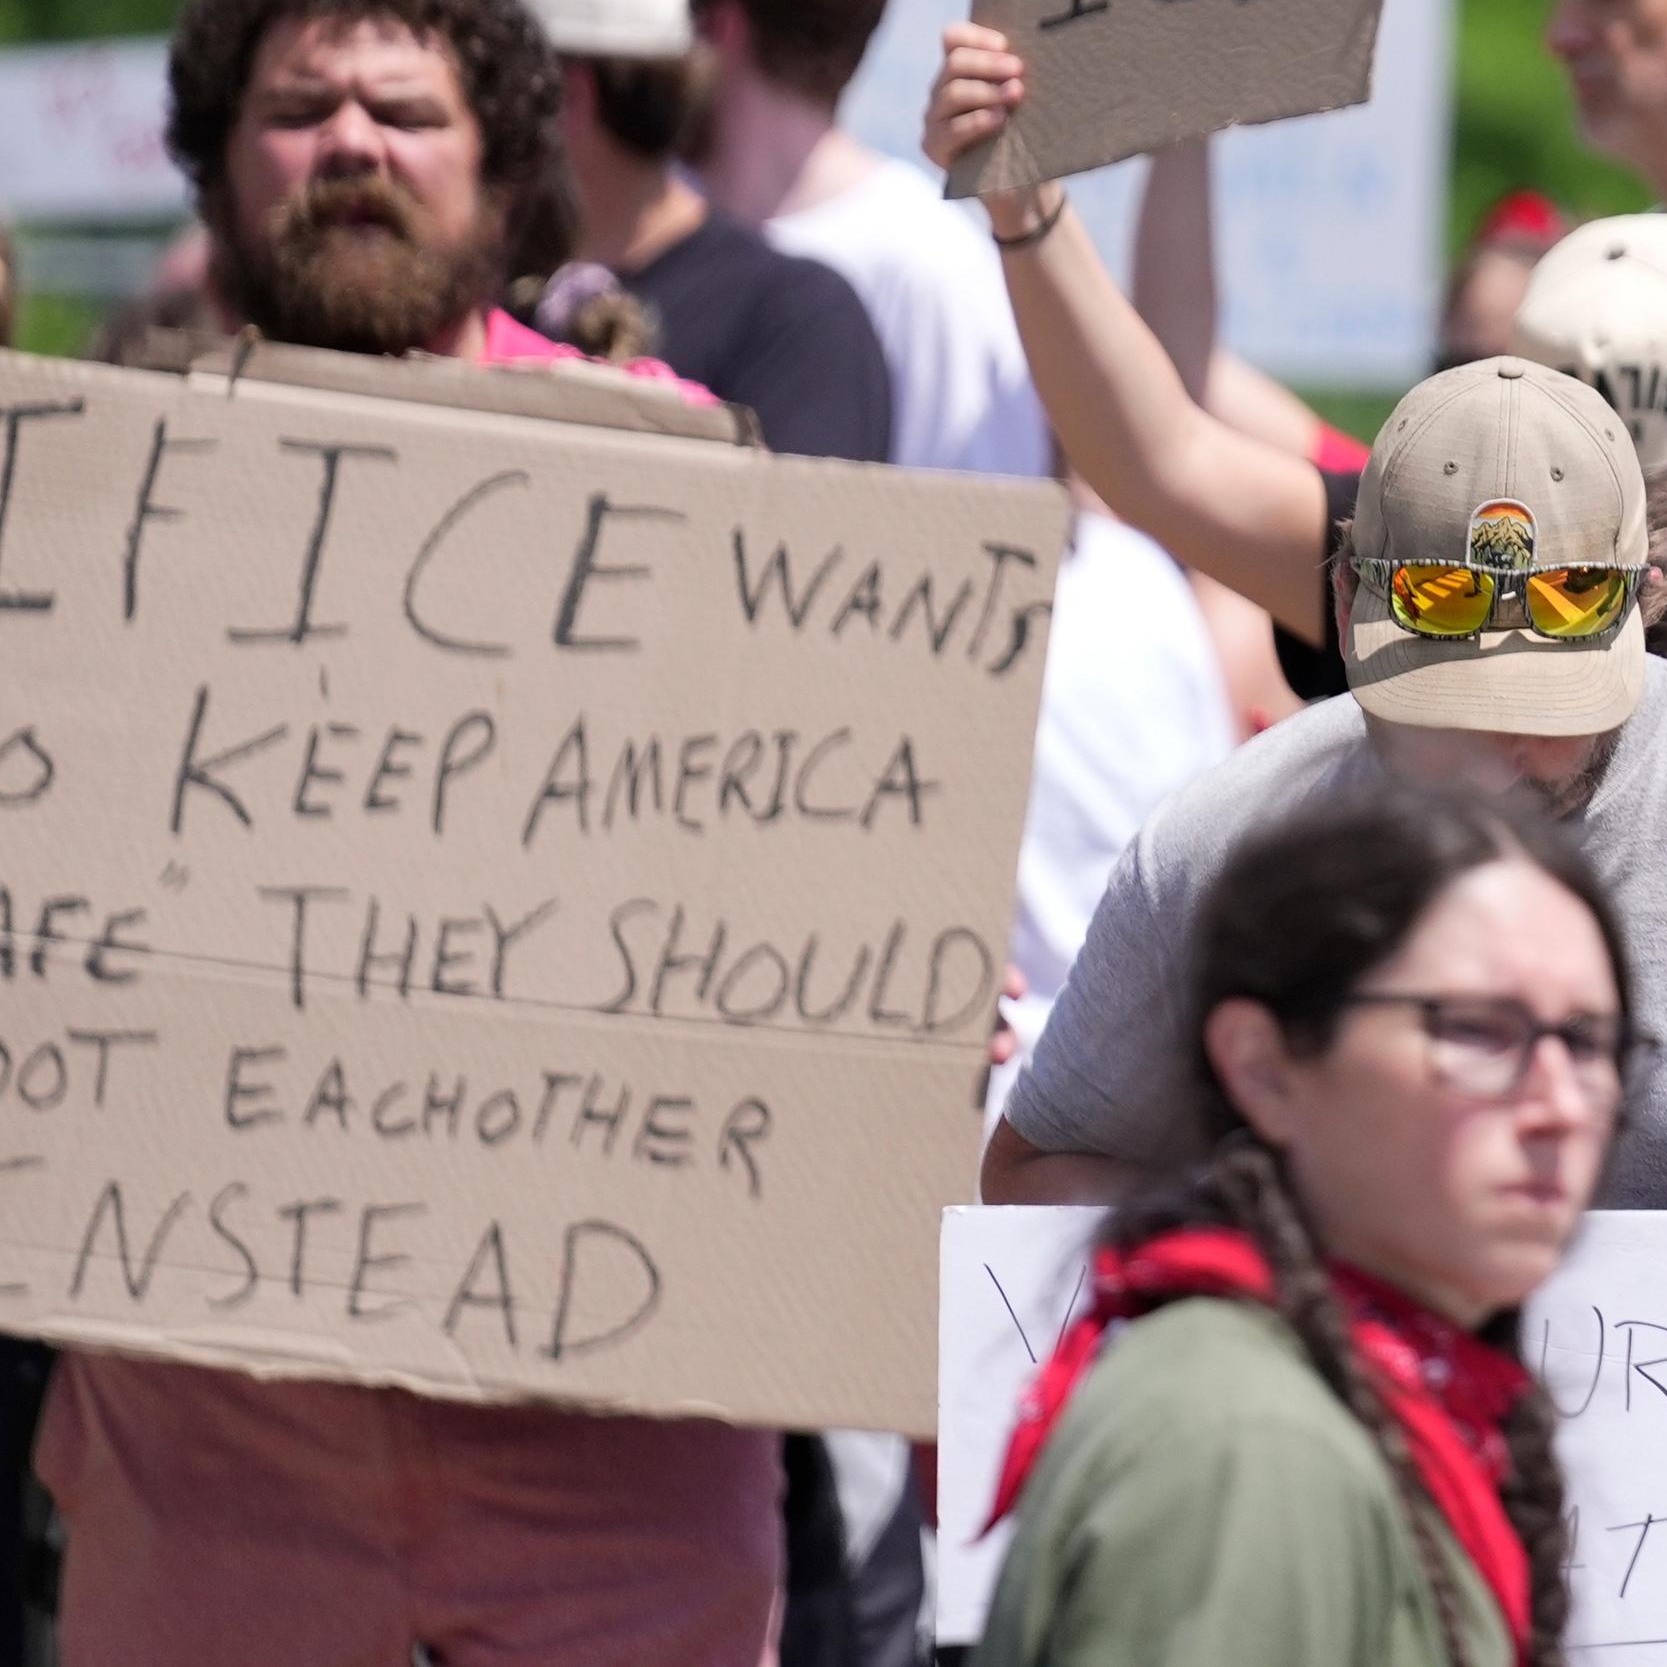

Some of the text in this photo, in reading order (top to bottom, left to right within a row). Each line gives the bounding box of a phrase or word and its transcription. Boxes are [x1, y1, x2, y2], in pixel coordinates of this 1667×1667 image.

[228, 436, 686, 658] ICE
[733, 525, 1052, 676] WANTS
[172, 684, 494, 834] KEEP
[523, 713, 938, 846] AMERICA
[257, 887, 558, 1011] THEY
[603, 897, 993, 1032] SHOULD
